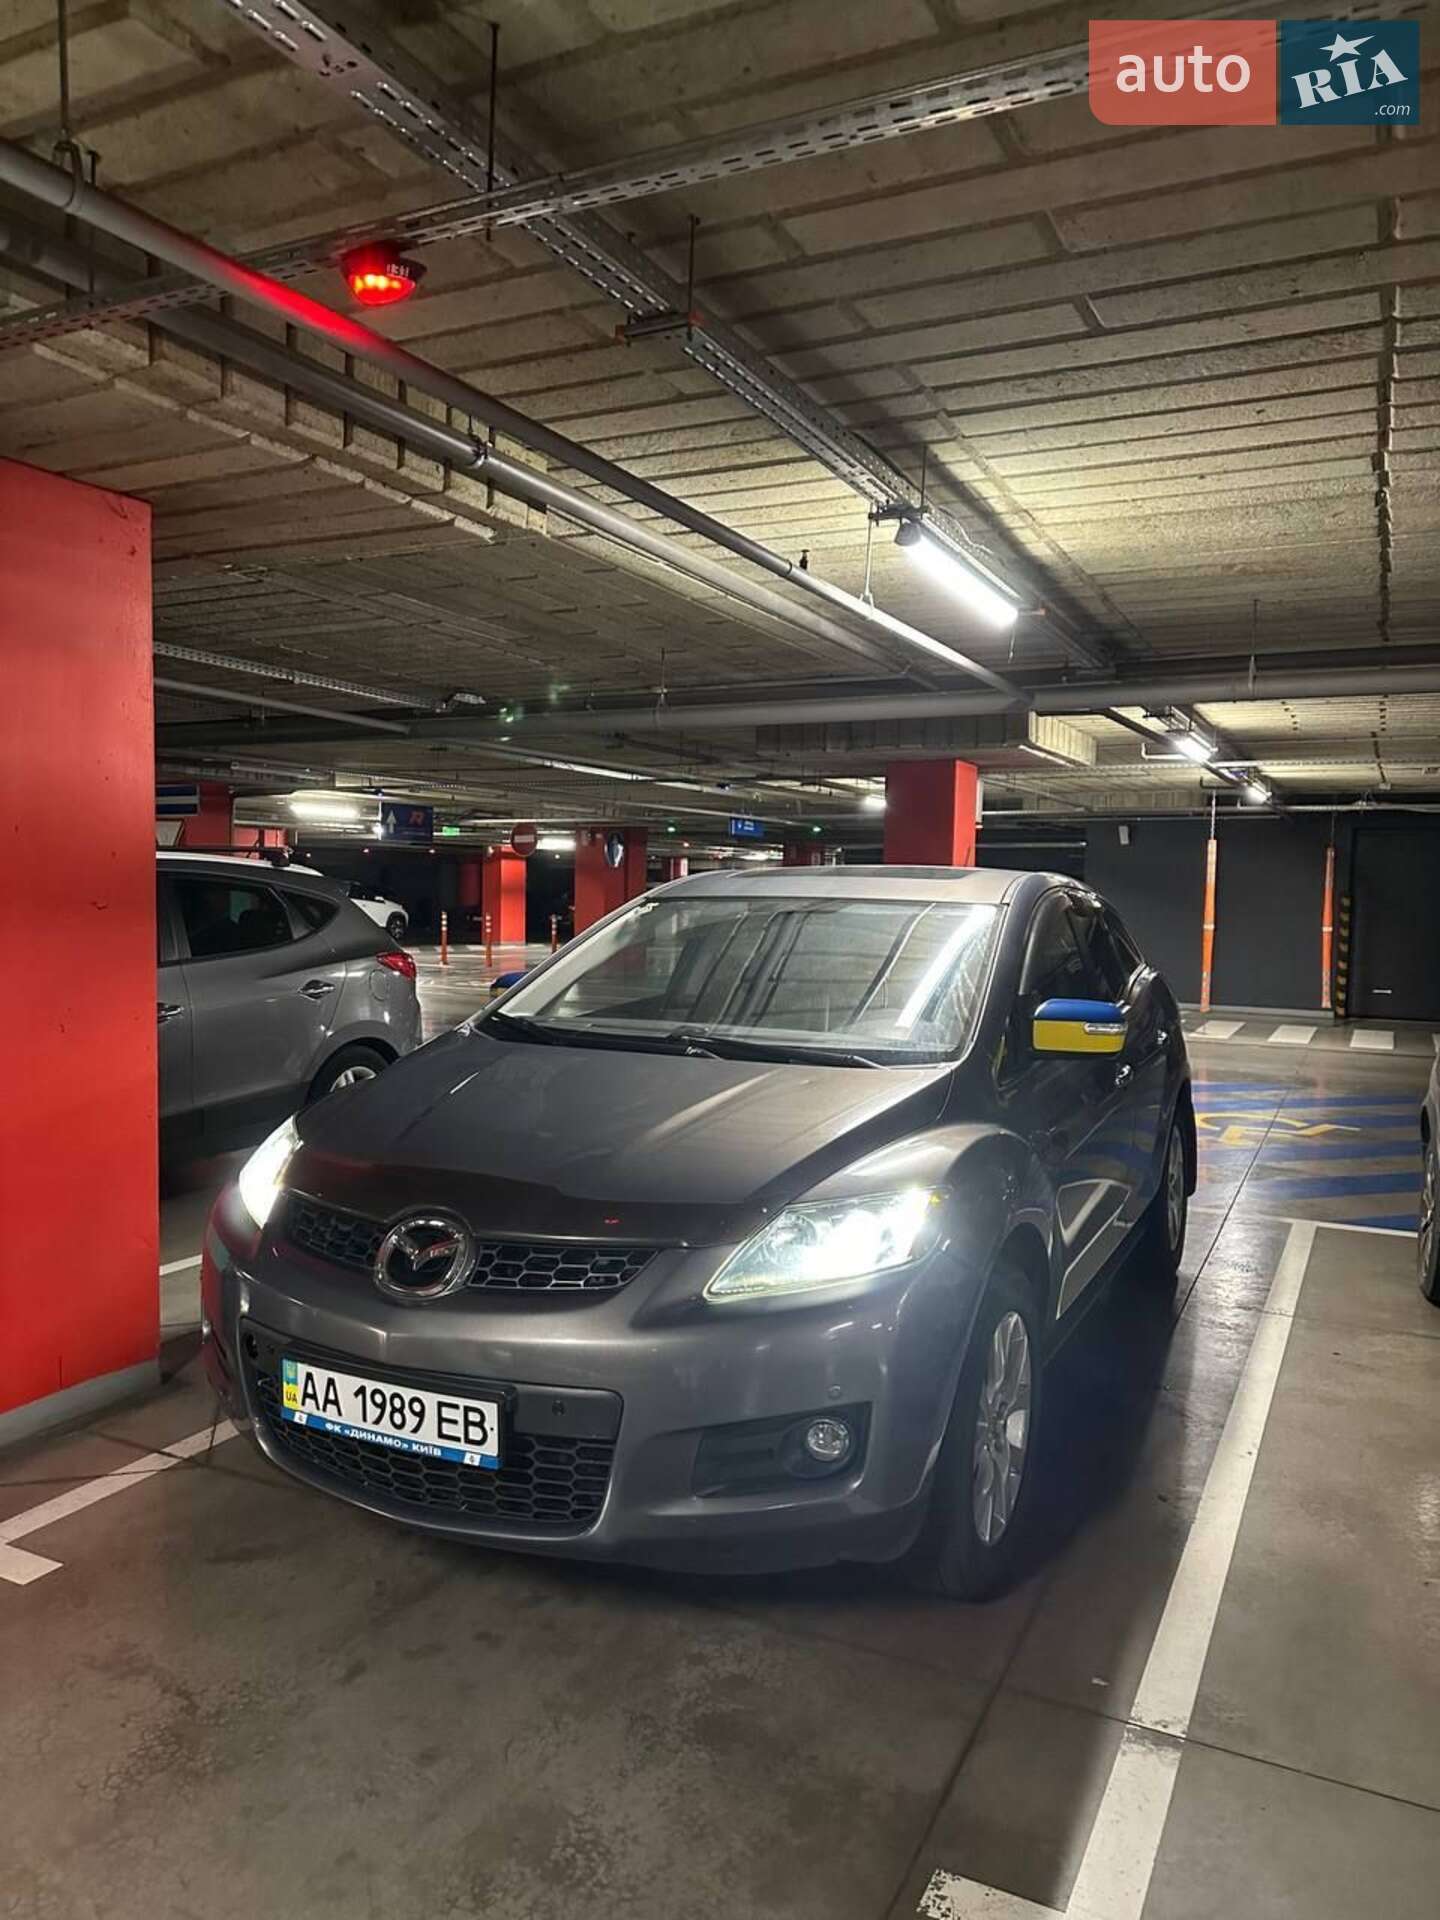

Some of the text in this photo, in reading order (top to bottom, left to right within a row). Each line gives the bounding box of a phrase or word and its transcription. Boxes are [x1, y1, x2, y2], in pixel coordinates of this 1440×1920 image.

[286, 1391, 298, 1404] UA
[301, 1371, 489, 1447] AA 1989 EB
[325, 1422, 442, 1457] ФК «ДИНАМО» КИЇВ
